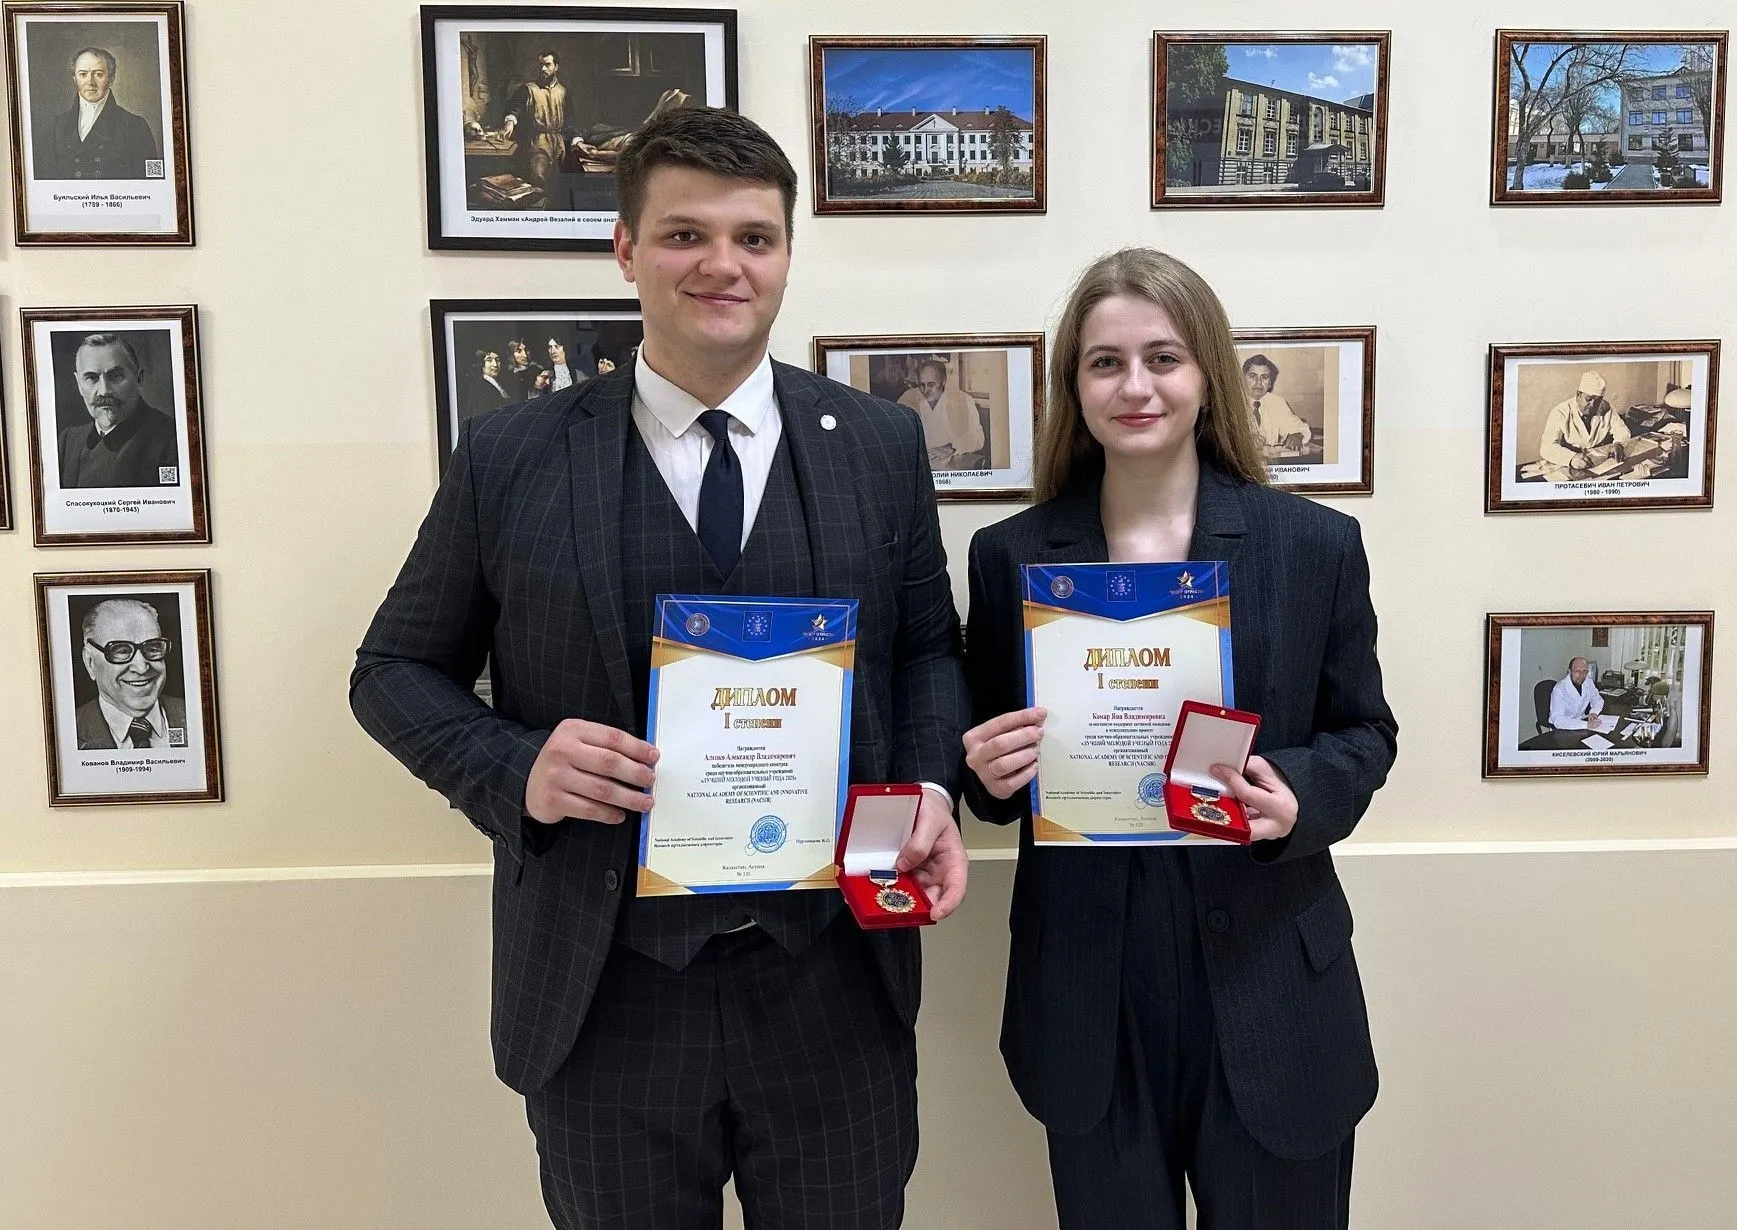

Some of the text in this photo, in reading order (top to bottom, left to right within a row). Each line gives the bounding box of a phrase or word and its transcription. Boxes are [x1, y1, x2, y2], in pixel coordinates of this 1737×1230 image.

[103, 506, 140, 514] (1870-1943)
[1084, 648, 1171, 671] ДИПЛОМ
[1098, 673, 1159, 689] I степени
[711, 688, 797, 710] ДИПЛОМ
[724, 713, 782, 729] I степени
